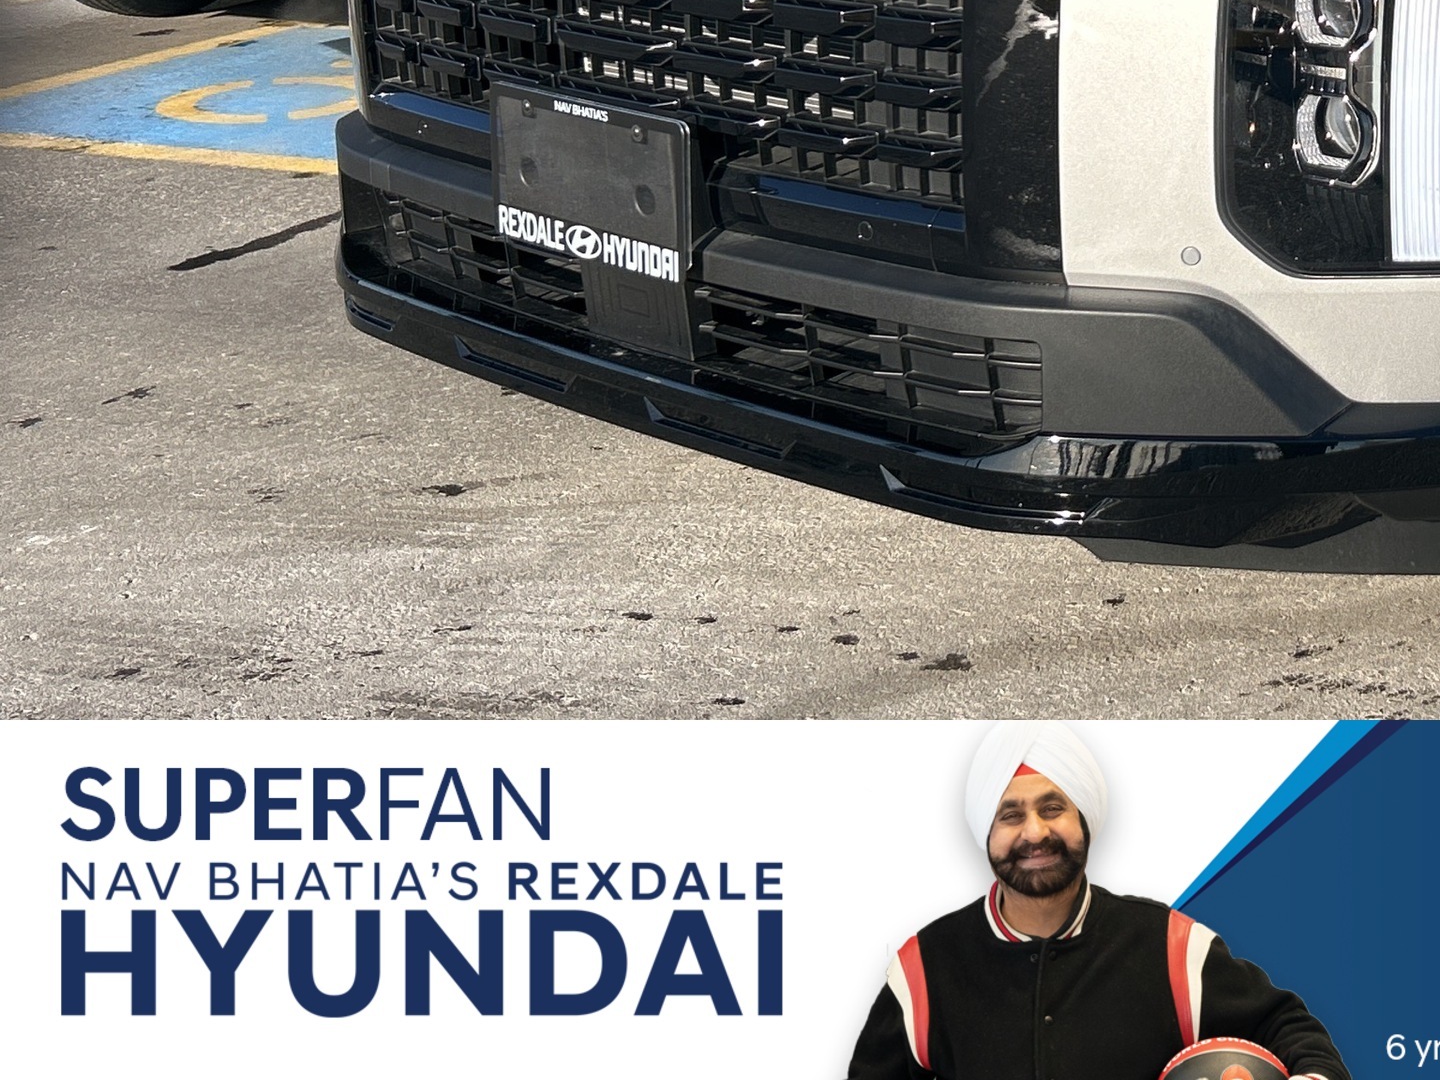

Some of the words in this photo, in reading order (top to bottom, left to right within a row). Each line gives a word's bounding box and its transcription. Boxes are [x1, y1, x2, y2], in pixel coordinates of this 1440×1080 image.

[554, 99, 572, 114] NAV
[572, 104, 609, 122] BHATIA'S
[498, 204, 565, 251] REXDALE
[602, 232, 680, 283] HYUNDAI
